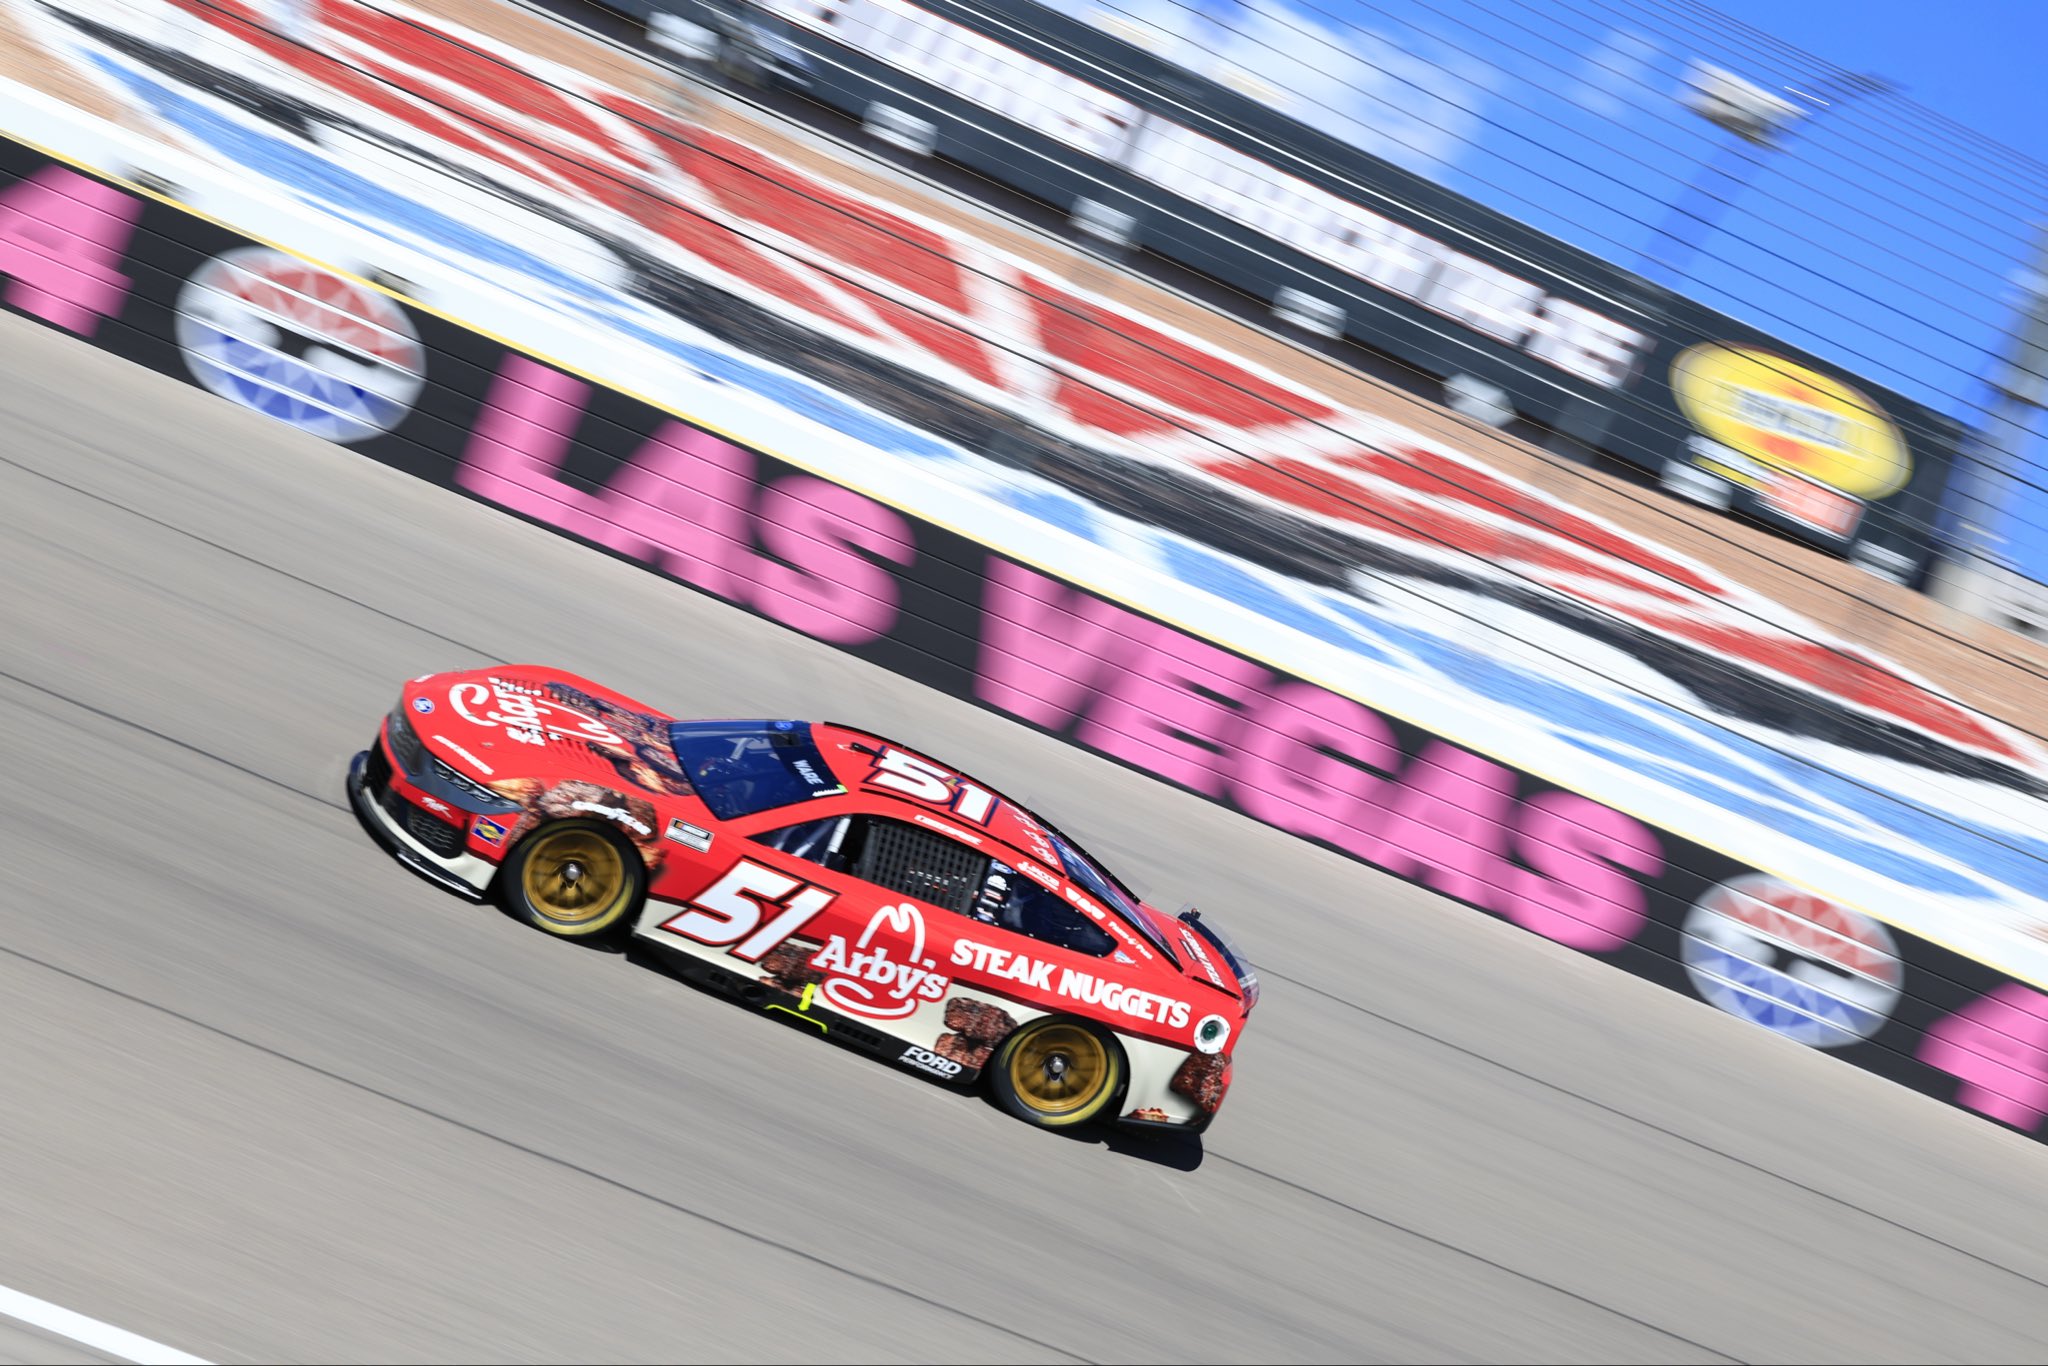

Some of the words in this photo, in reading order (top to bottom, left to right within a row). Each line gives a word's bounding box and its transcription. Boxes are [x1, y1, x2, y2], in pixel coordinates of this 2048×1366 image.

[454, 352, 916, 645] LAS
[974, 556, 1666, 953] VEGAS
[792, 759, 824, 786] WARE
[864, 744, 1000, 827] 51
[660, 854, 841, 963] 51
[810, 934, 948, 999] Arby's
[950, 938, 1058, 992] STEAK
[1057, 972, 1192, 1029] NUGGETS
[902, 1046, 962, 1075] FORD
